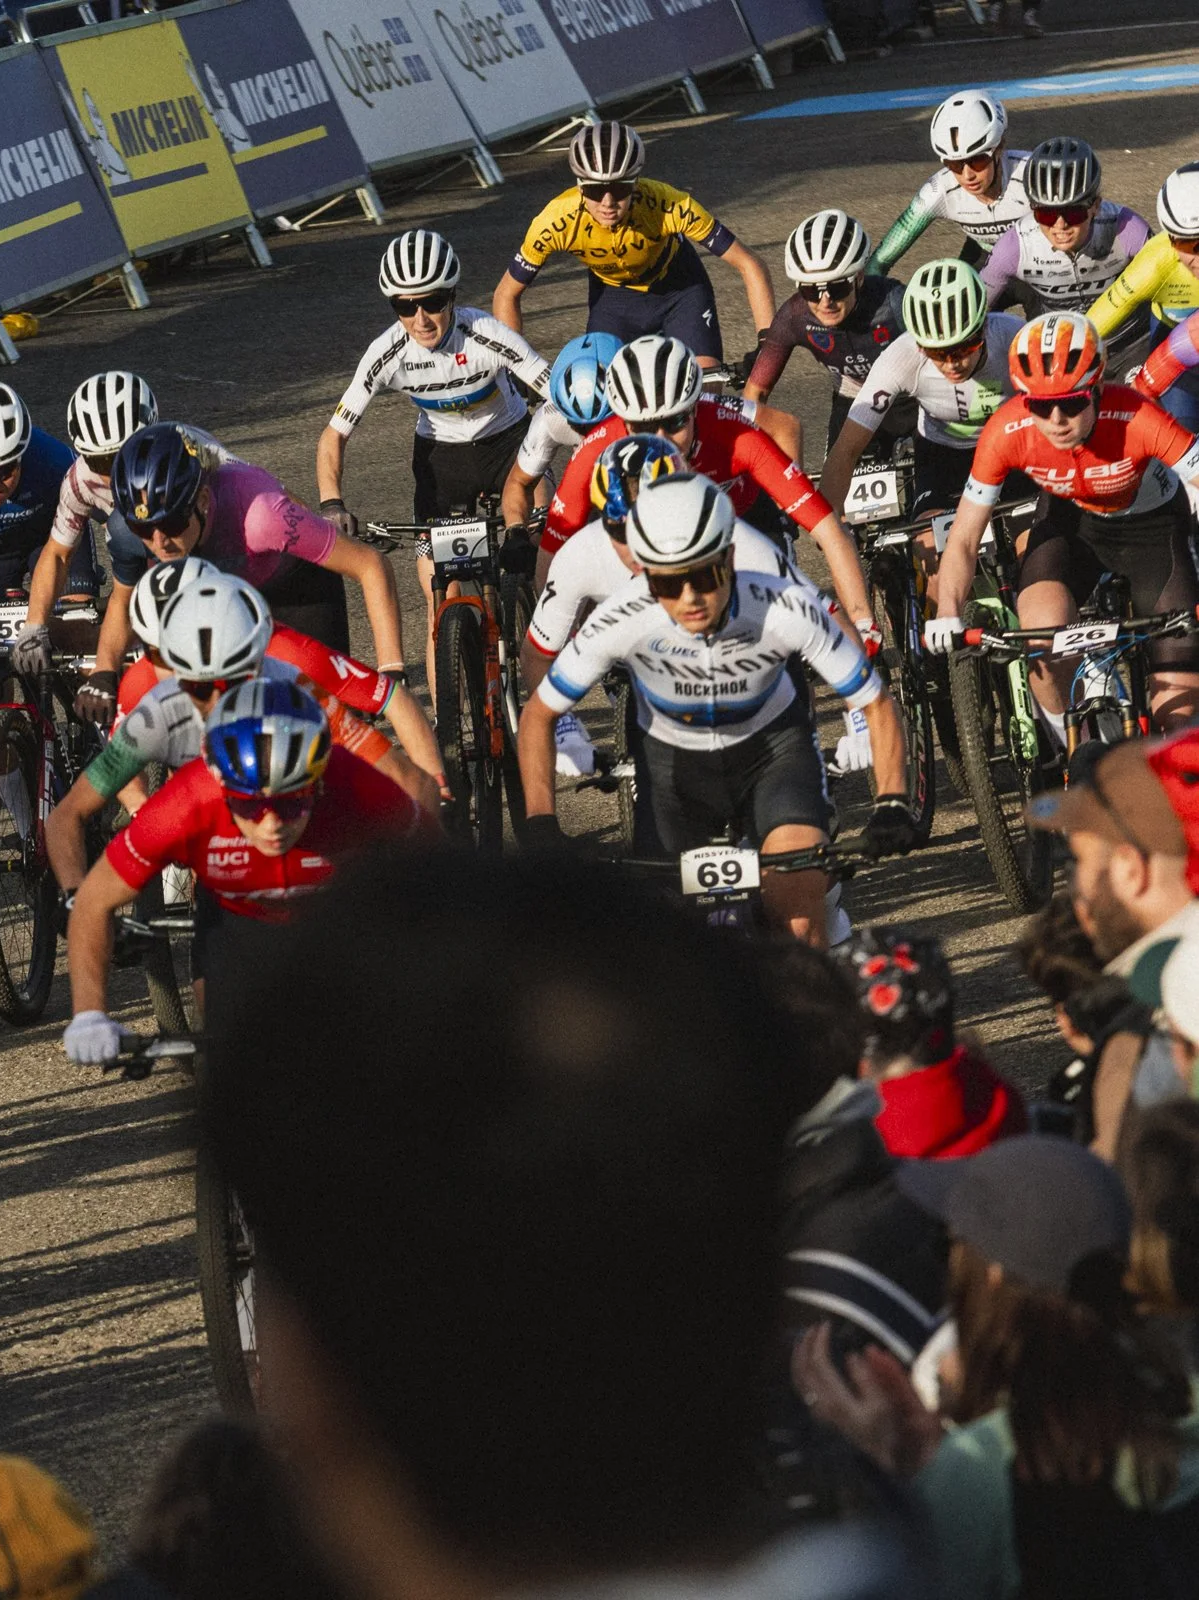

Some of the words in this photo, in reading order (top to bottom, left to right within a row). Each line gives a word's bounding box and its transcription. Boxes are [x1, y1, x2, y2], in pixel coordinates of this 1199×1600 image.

[323, 23, 411, 109] Québec
[230, 60, 329, 126] MICHELIN
[111, 95, 209, 158] MICHELIN
[457, 323, 524, 365] MASSI
[364, 333, 410, 395] MASSI
[845, 354, 869, 364] C.S.
[402, 369, 491, 394] MASSI
[1004, 416, 1035, 435] CUB
[852, 464, 889, 476] WHOOP
[1024, 456, 1134, 481] CUBE
[852, 479, 887, 502] 40
[440, 517, 478, 526] WHOOP
[451, 537, 469, 557] 6
[1064, 629, 1106, 646] 26
[634, 648, 786, 683] CANYON
[207, 835, 255, 849] Santin
[697, 860, 743, 888] 69
